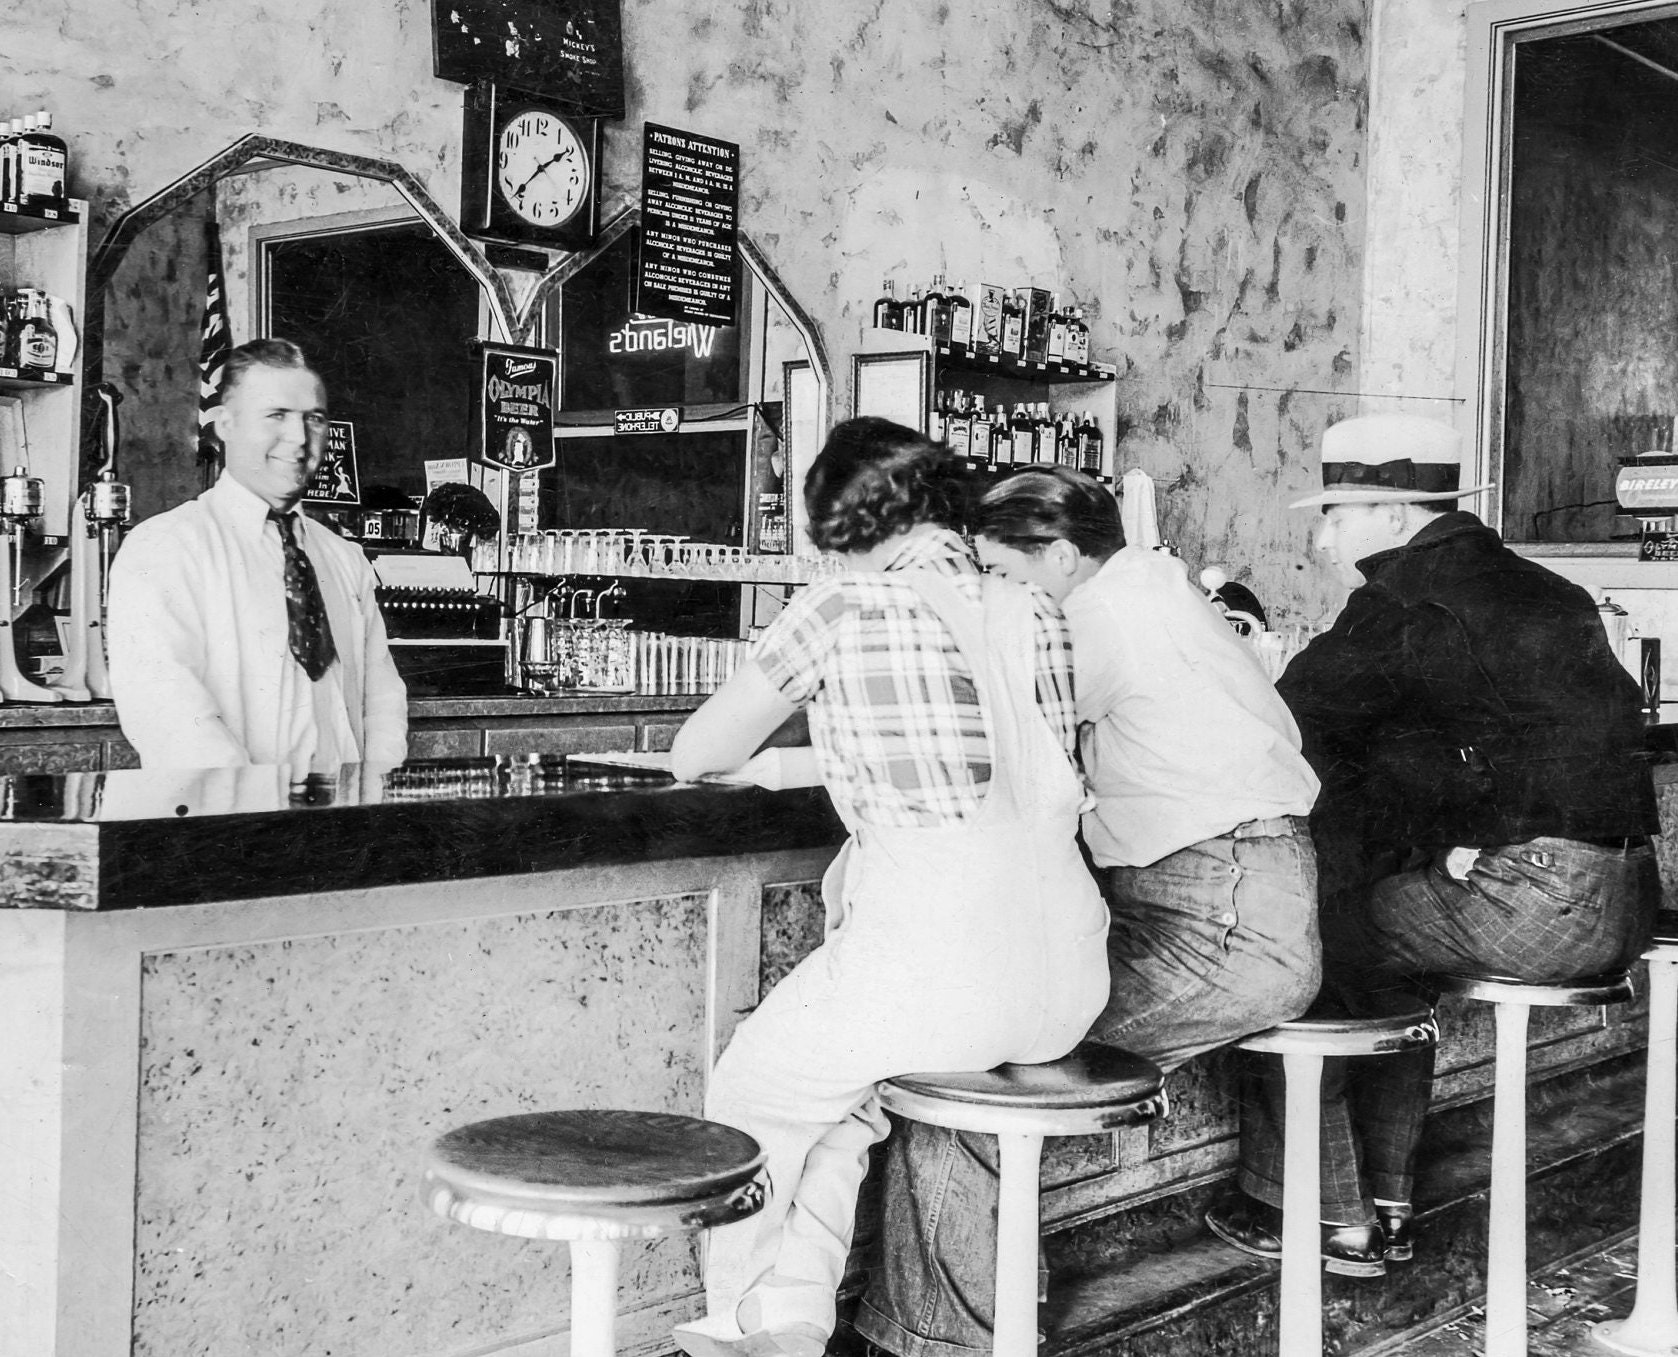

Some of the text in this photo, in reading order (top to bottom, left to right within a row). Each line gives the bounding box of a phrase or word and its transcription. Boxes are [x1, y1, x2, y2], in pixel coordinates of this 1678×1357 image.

[518, 119, 531, 137] 11
[537, 117, 549, 136] 12
[506, 130, 519, 148] 10
[654, 132, 729, 158] PATRONS ATTENTION
[28, 156, 64, 169] Windsor
[500, 151, 508, 170] 9
[675, 155, 695, 164] GIVING
[698, 160, 713, 168] AWAY
[570, 168, 579, 185] 3
[649, 158, 733, 182] LIVERING ALCOHOLIC BEVERAGES
[649, 167, 673, 177] BETWEEN
[567, 188, 573, 206] 4
[532, 202, 542, 218] 6
[550, 200, 558, 218] 5
[647, 198, 662, 206] AWAY
[665, 202, 693, 212] ALCOHOLIC
[695, 208, 723, 219] BEVERAGES
[715, 203, 732, 212] GIVING
[696, 217, 712, 225] YEARS
[646, 239, 675, 250] ALCOHOLIC
[676, 245, 705, 256] BEVERAGES
[714, 252, 731, 261] GUILTY
[661, 232, 680, 241] MINOR
[683, 237, 696, 245] WHO
[698, 240, 732, 252] PURCHASES
[644, 272, 677, 282] ALCOHOLIC
[678, 277, 710, 288] BEVERAGES
[660, 265, 680, 273] MINOR
[699, 272, 731, 282] CONSUMES
[700, 290, 717, 298] GUILTY
[505, 358, 536, 377] Famous
[488, 374, 550, 409] OLYMPIA
[501, 401, 539, 416] BEER
[329, 428, 346, 438] IVE
